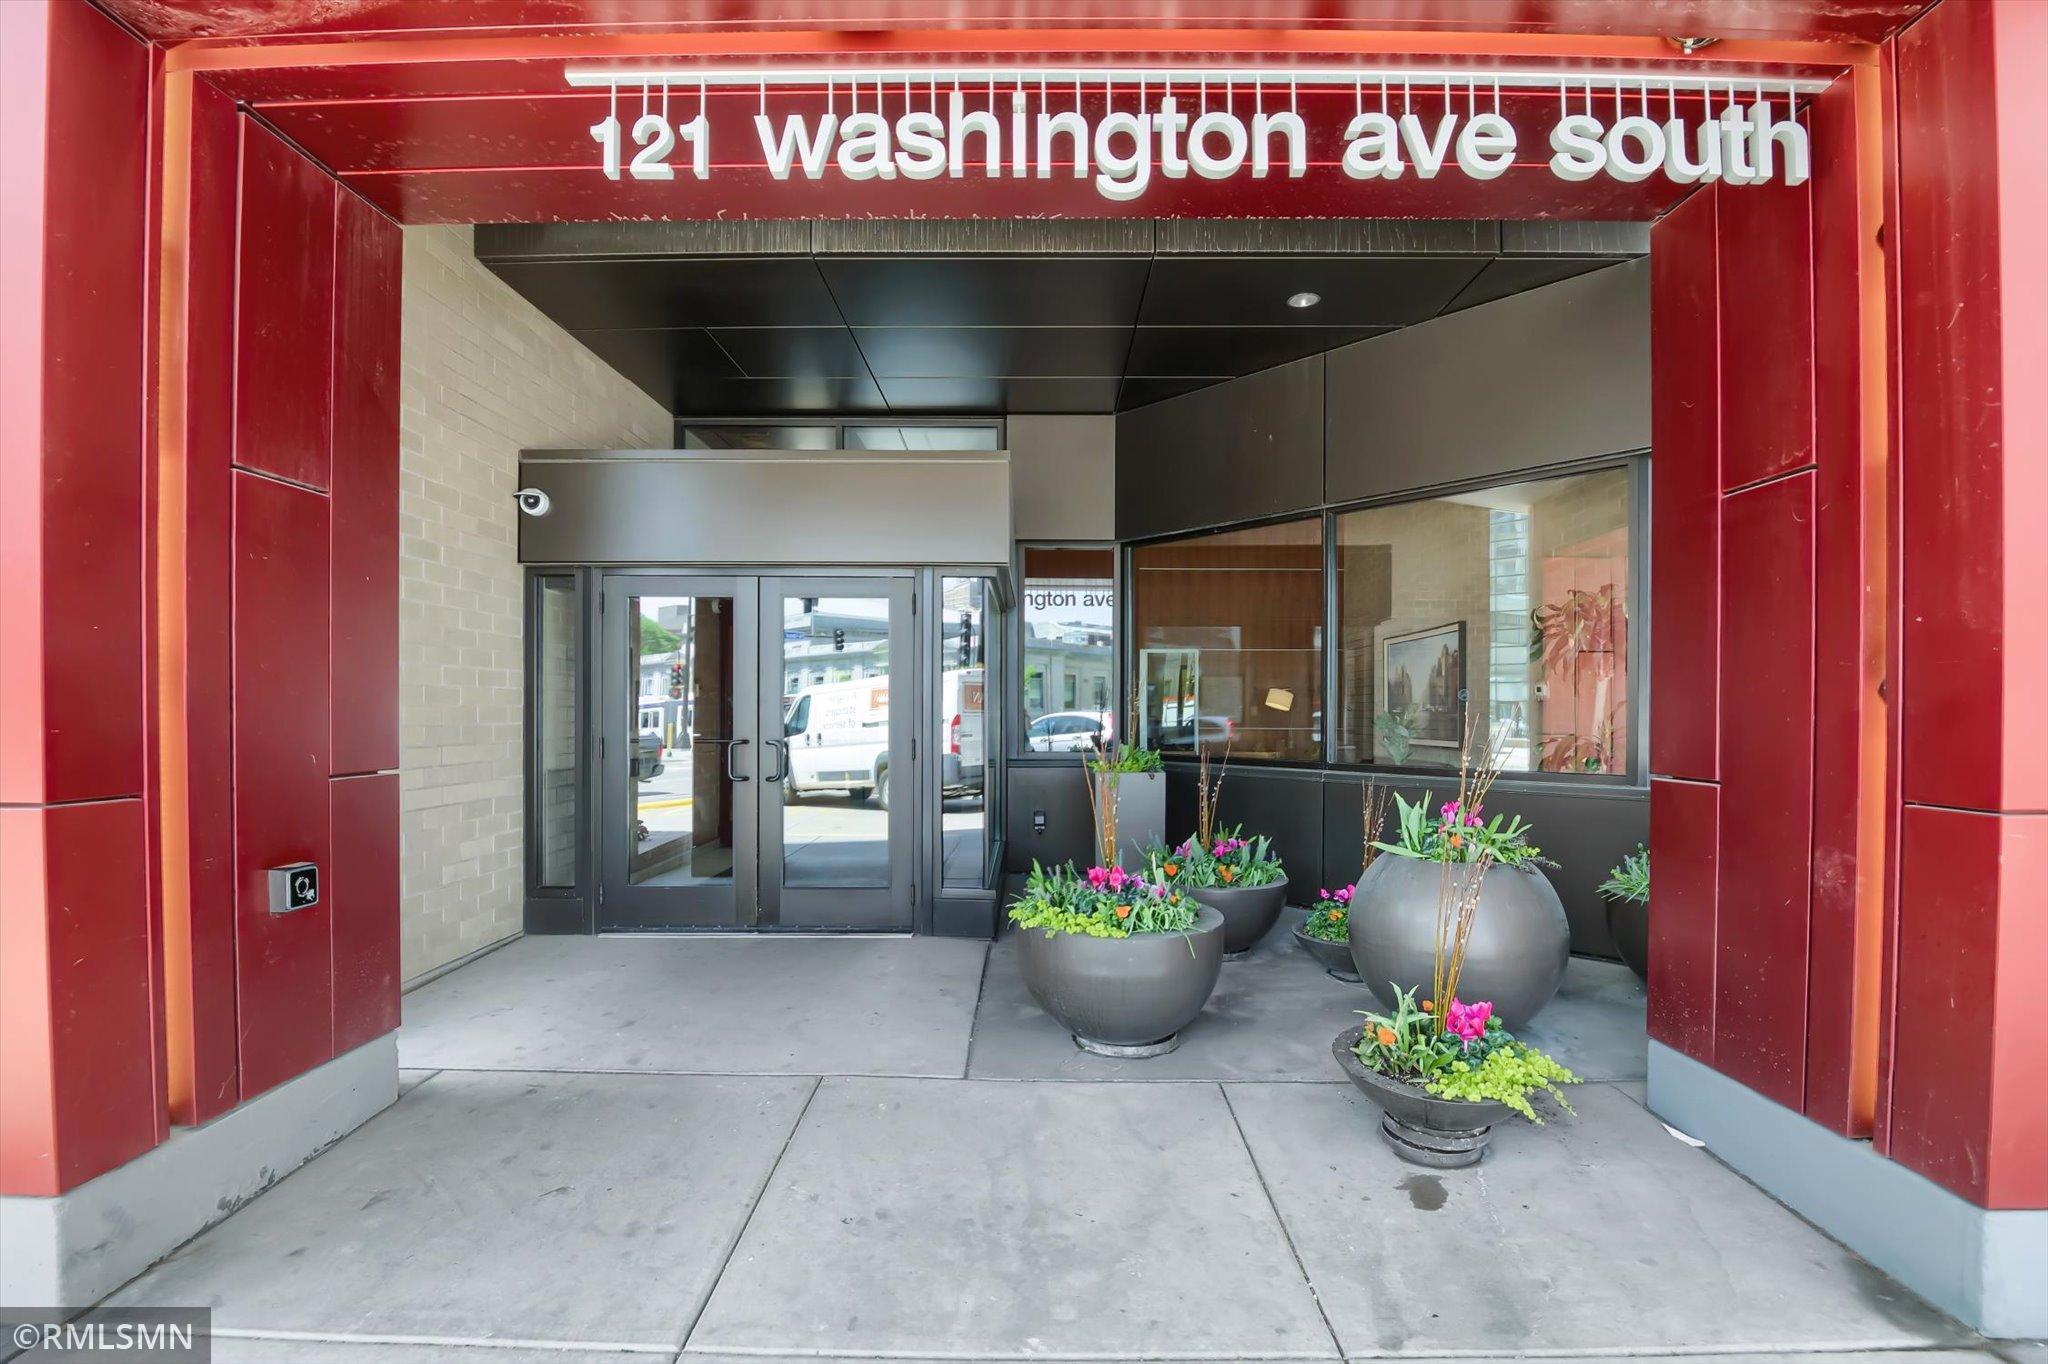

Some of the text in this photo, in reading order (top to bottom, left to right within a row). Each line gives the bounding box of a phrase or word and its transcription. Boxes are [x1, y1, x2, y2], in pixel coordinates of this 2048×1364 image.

[590, 91, 1809, 201] 121 washington ave south
